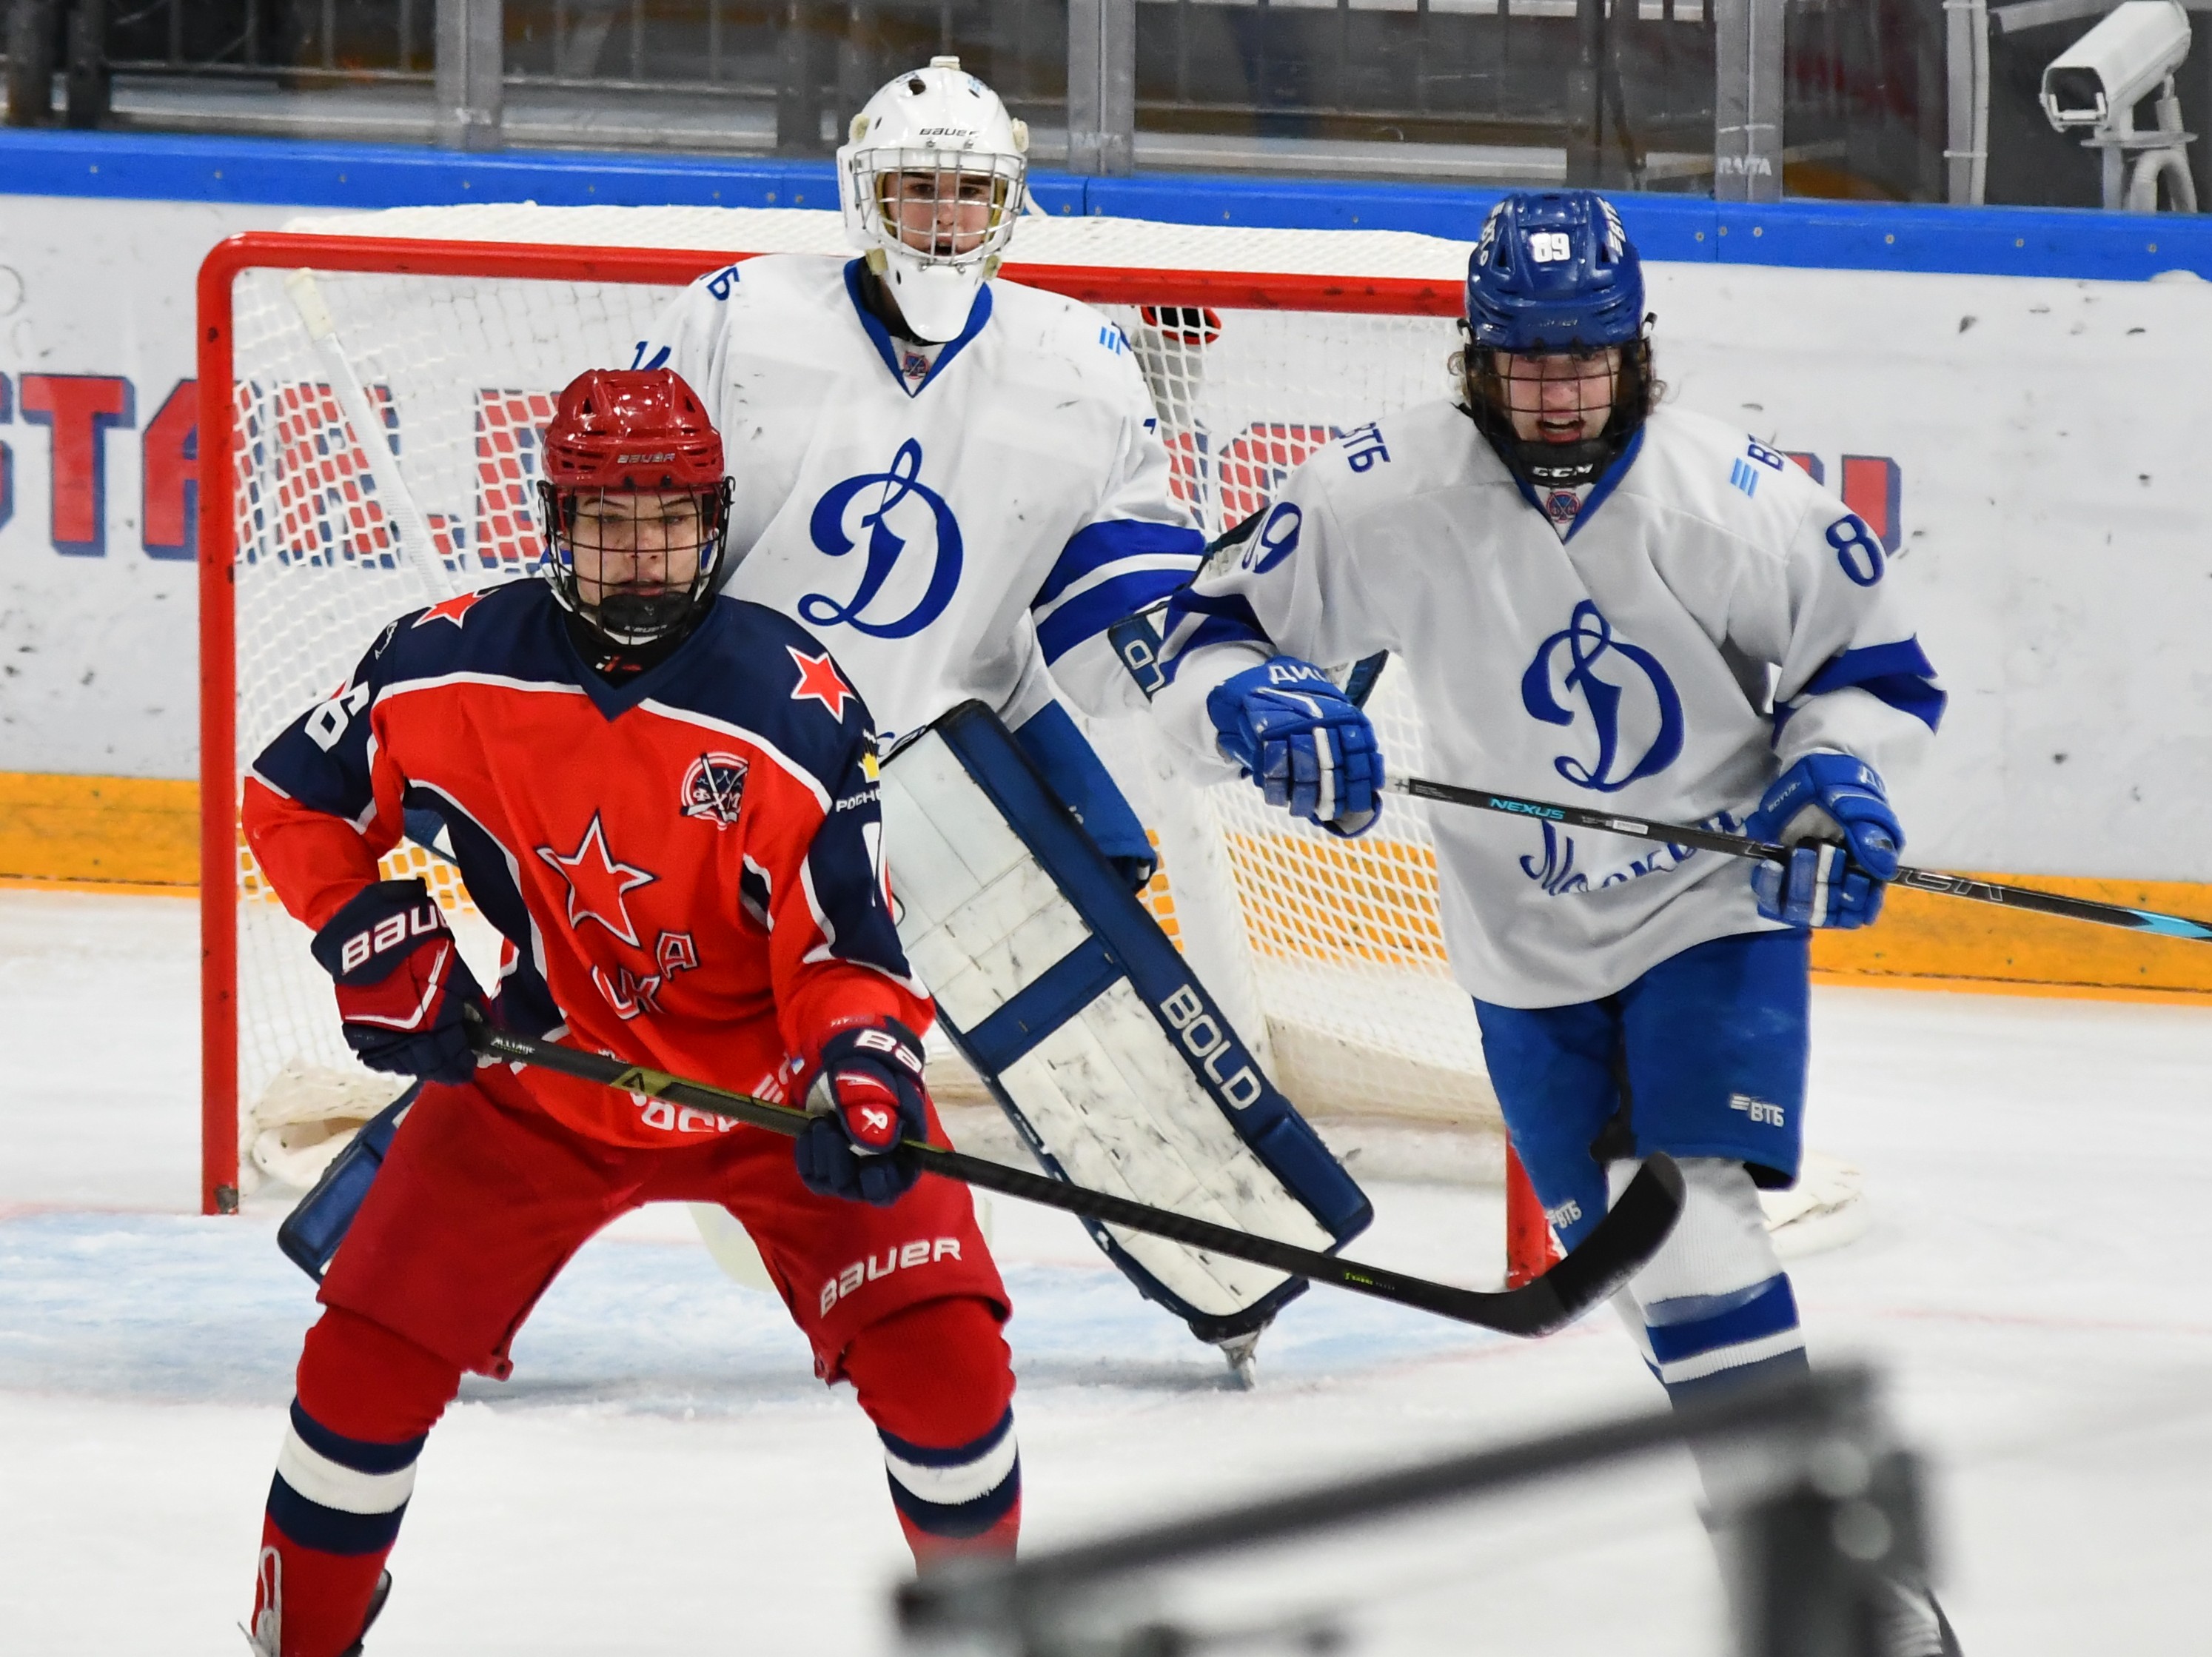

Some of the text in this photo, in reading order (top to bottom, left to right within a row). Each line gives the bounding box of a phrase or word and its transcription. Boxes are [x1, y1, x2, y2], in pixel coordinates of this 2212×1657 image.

[1529, 232, 1571, 263] 89
[617, 450, 676, 464] BAUER
[1532, 463, 1594, 478] CCM
[1489, 797, 1566, 820] NEXUS
[341, 904, 449, 976] BAU
[1159, 983, 1262, 1111] BOLD
[1751, 1102, 1785, 1128] ВТБ
[820, 1236, 962, 1319] BAUER
